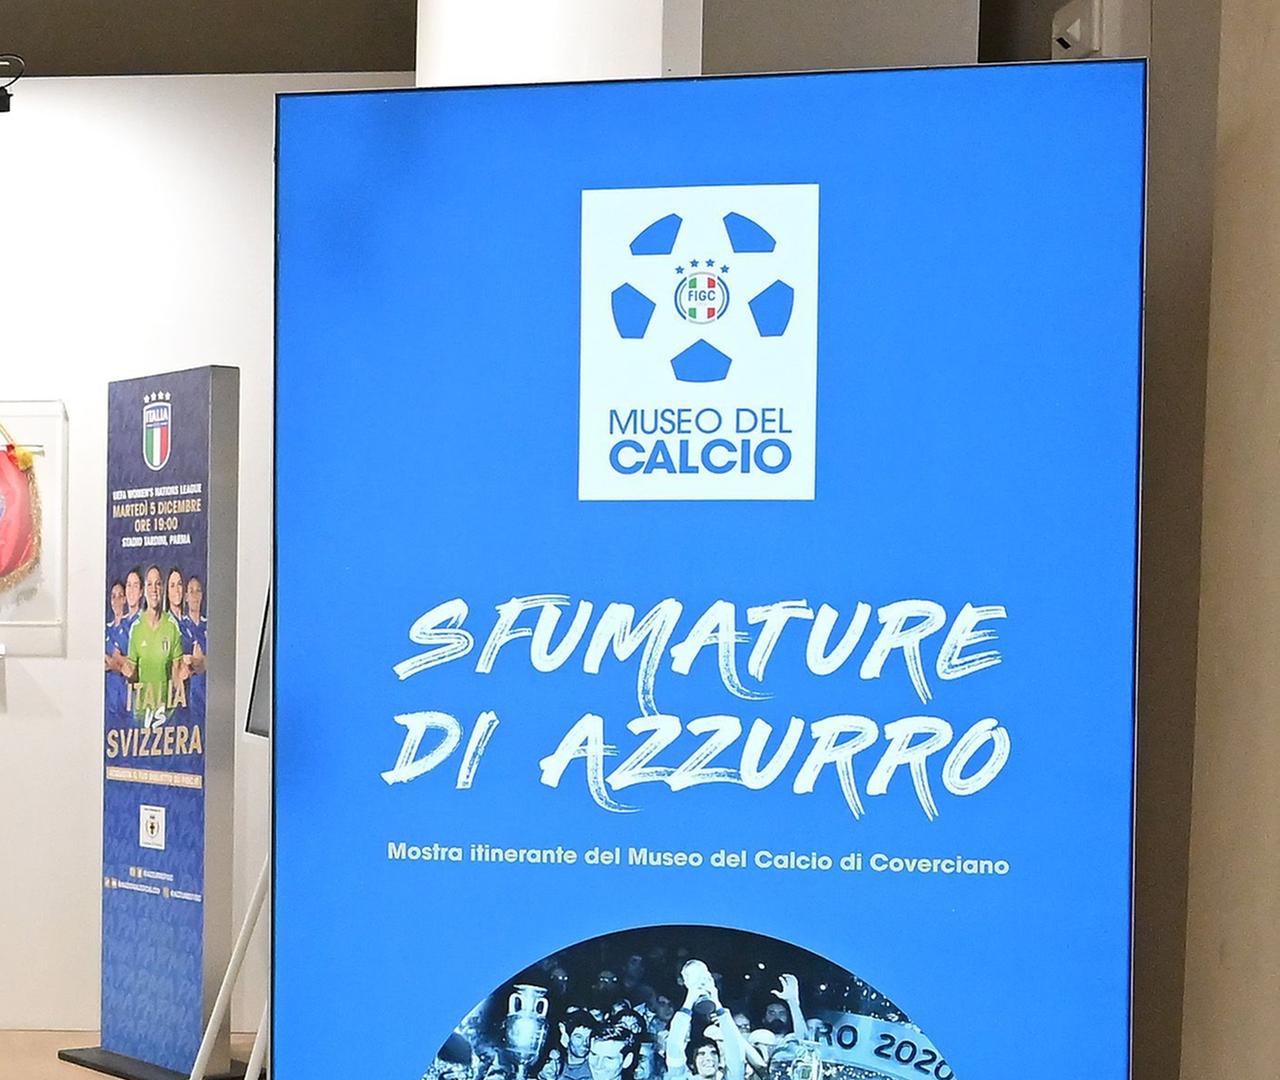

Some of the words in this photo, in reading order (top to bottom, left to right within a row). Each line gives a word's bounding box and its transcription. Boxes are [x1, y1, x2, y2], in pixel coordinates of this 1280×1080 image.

[688, 290, 716, 302] FIGC
[609, 408, 722, 435] MUSEO
[736, 408, 793, 434] DEL
[609, 439, 793, 475] CALCIO
[150, 502, 156, 515] 5
[158, 499, 201, 514] DICEMBRE
[134, 519, 151, 532] ORE
[154, 517, 178, 531] 19:00
[393, 595, 1007, 708] SFUMATURE
[127, 679, 187, 712] ITALIA
[106, 724, 203, 758] SVIZZERA
[381, 709, 500, 789] DI
[539, 713, 1011, 822] AZZURRO
[387, 842, 463, 861] Mostra
[470, 844, 578, 864] itinerante
[584, 846, 621, 865] del
[628, 847, 703, 867] Museo
[710, 849, 747, 868] del
[754, 850, 833, 871] Calcio
[839, 853, 862, 871] di
[869, 853, 1010, 875] Coverciano
